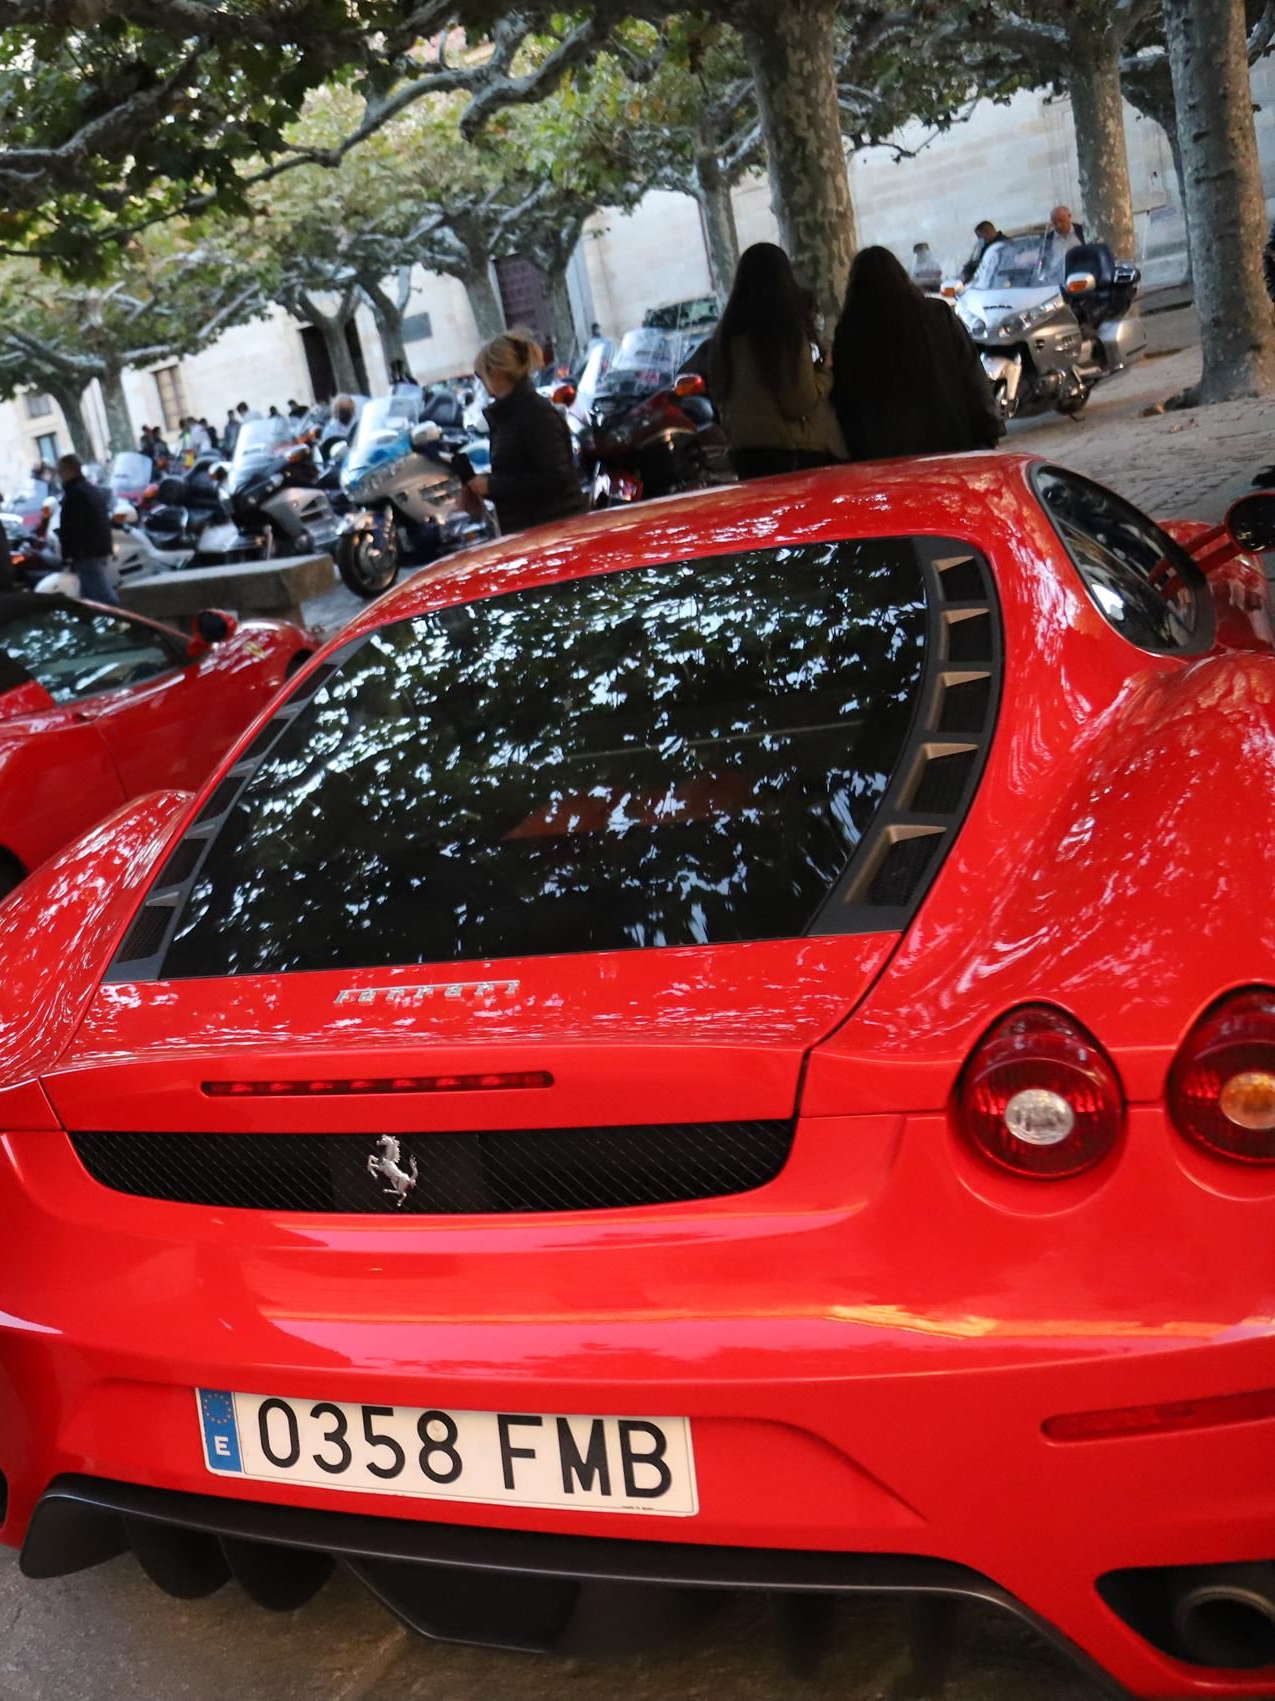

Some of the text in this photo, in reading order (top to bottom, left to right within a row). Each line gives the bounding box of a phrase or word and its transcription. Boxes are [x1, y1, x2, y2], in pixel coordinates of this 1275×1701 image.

[214, 1435, 231, 1456] E
[258, 1398, 673, 1499] 0358 FMB
